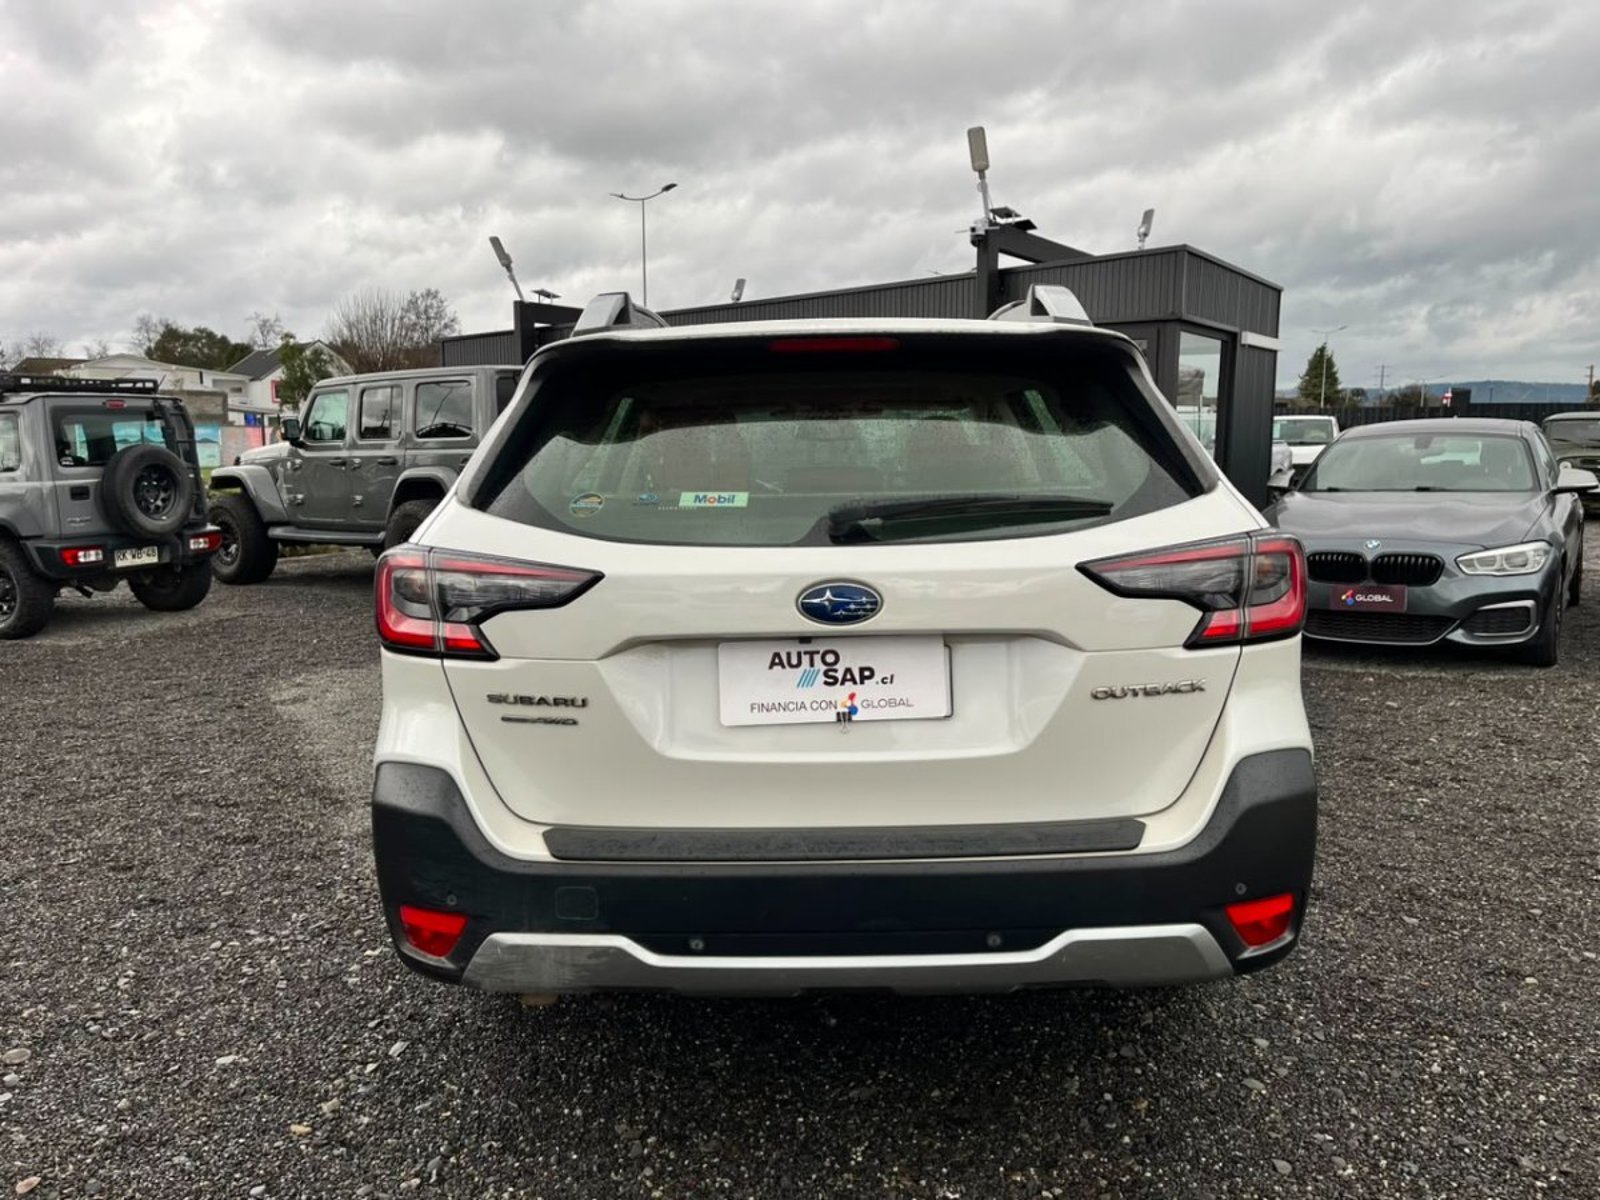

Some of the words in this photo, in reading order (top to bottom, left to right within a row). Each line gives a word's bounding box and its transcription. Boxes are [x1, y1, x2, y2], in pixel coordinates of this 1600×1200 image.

[693, 494, 736, 505] Mobil
[1355, 593, 1394, 603] GLOBAL
[768, 648, 841, 670] AUTO
[1090, 679, 1206, 700] OUTBACK
[486, 693, 588, 708] SUBARU
[750, 700, 808, 713] FINANCIA
[811, 699, 838, 711] CON
[860, 697, 914, 710] GLOBAL
